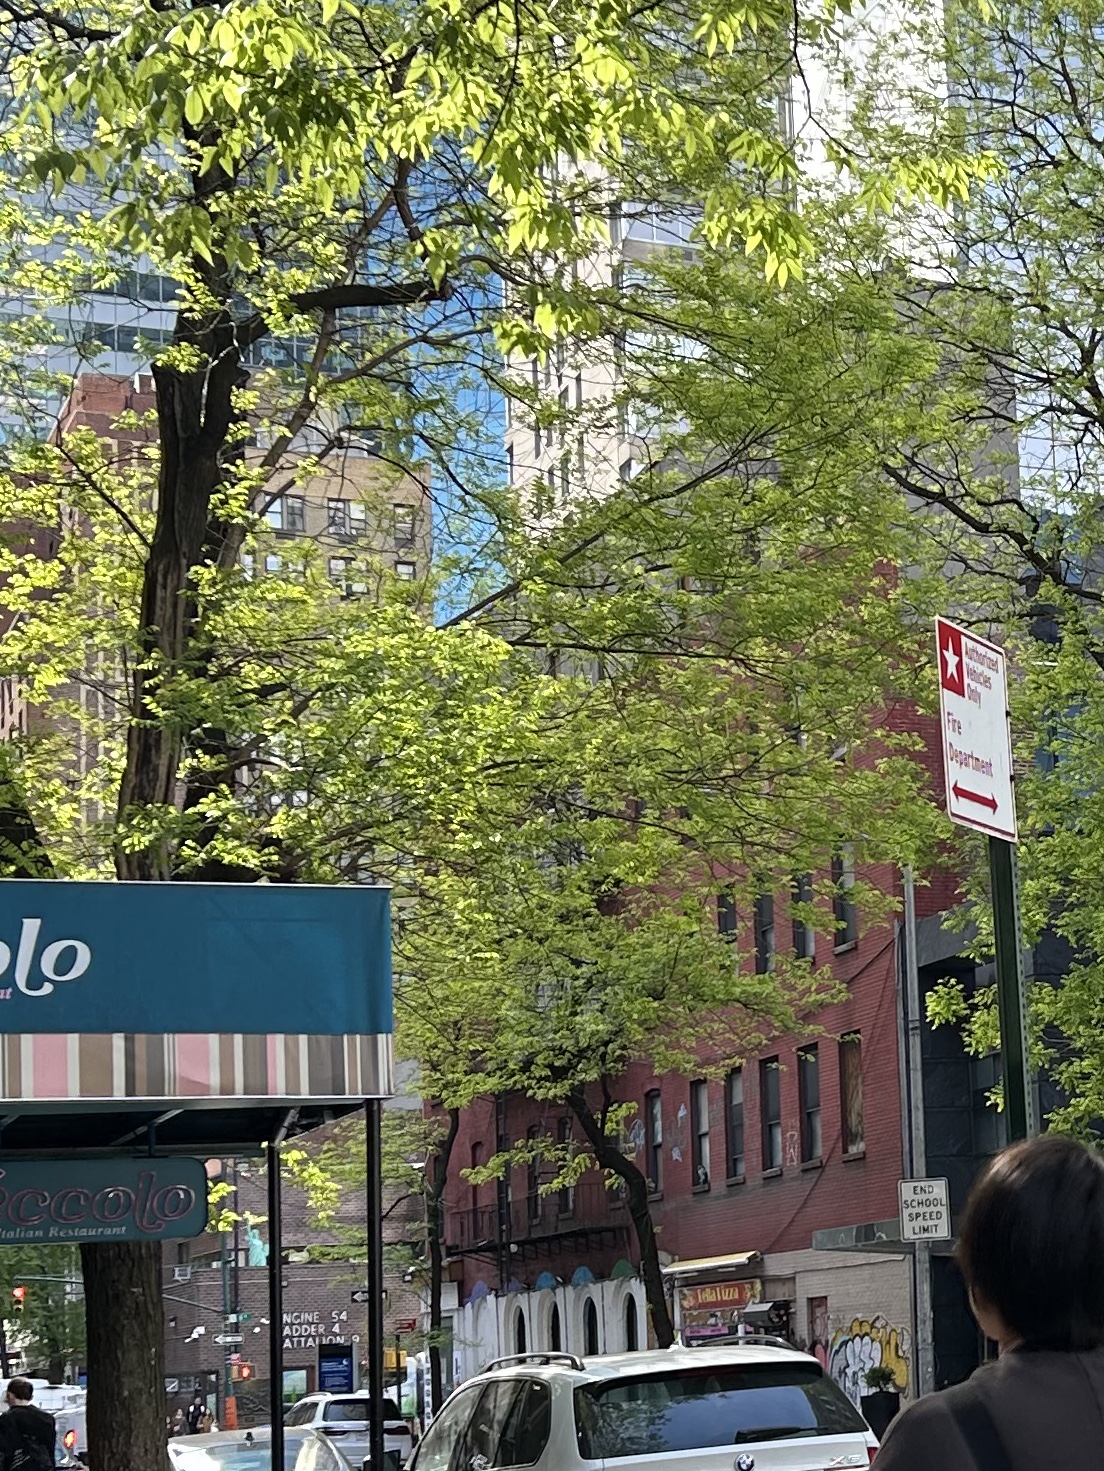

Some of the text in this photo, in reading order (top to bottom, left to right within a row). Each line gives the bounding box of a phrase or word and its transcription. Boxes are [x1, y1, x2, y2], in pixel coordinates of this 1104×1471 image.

[964, 641, 999, 674] Authorized
[965, 661, 992, 690] Vehicles
[966, 682, 981, 710] Only
[947, 711, 962, 736] Fire
[949, 742, 993, 777] Department
[0, 918, 92, 997] lo
[912, 1185, 934, 1195] END
[0, 1169, 196, 1233] ccolo
[903, 1197, 946, 1209] SCHOOL
[908, 1211, 942, 1222] SPEED
[48, 1226, 127, 1238] Restaurant
[912, 1224, 938, 1235] LIMIT
[282, 1310, 348, 1324] NGINE 54
[282, 1323, 340, 1337] ADDER 4
